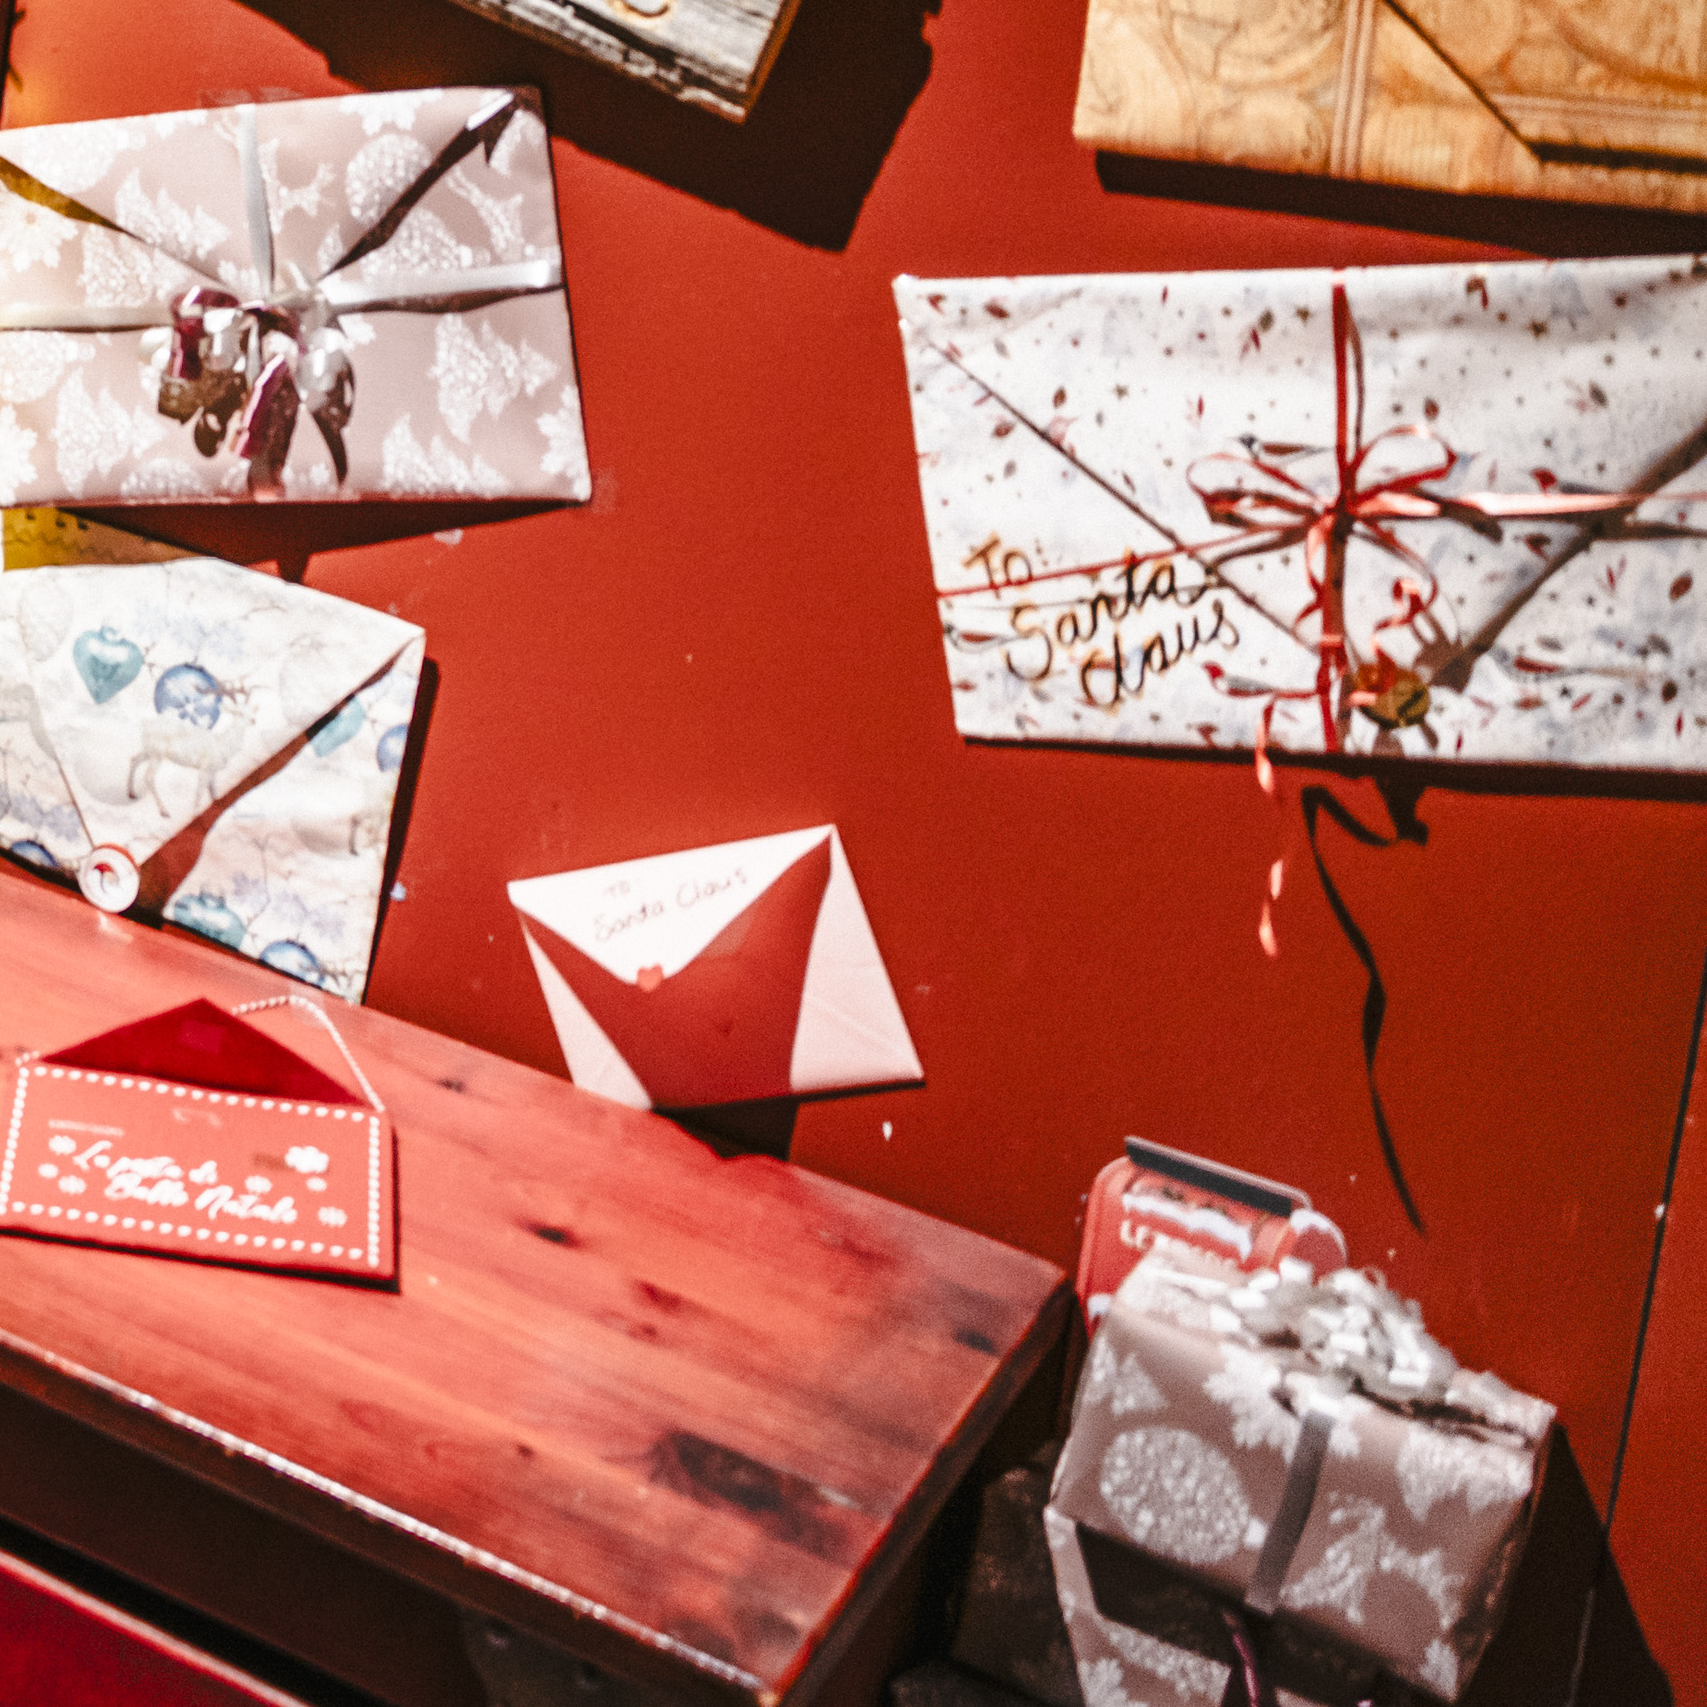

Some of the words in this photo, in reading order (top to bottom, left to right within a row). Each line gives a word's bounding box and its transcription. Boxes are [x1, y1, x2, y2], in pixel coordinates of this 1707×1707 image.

[1001, 546, 1206, 683] Santa
[594, 901, 665, 942] Santa
[676, 867, 748, 908] Claus
